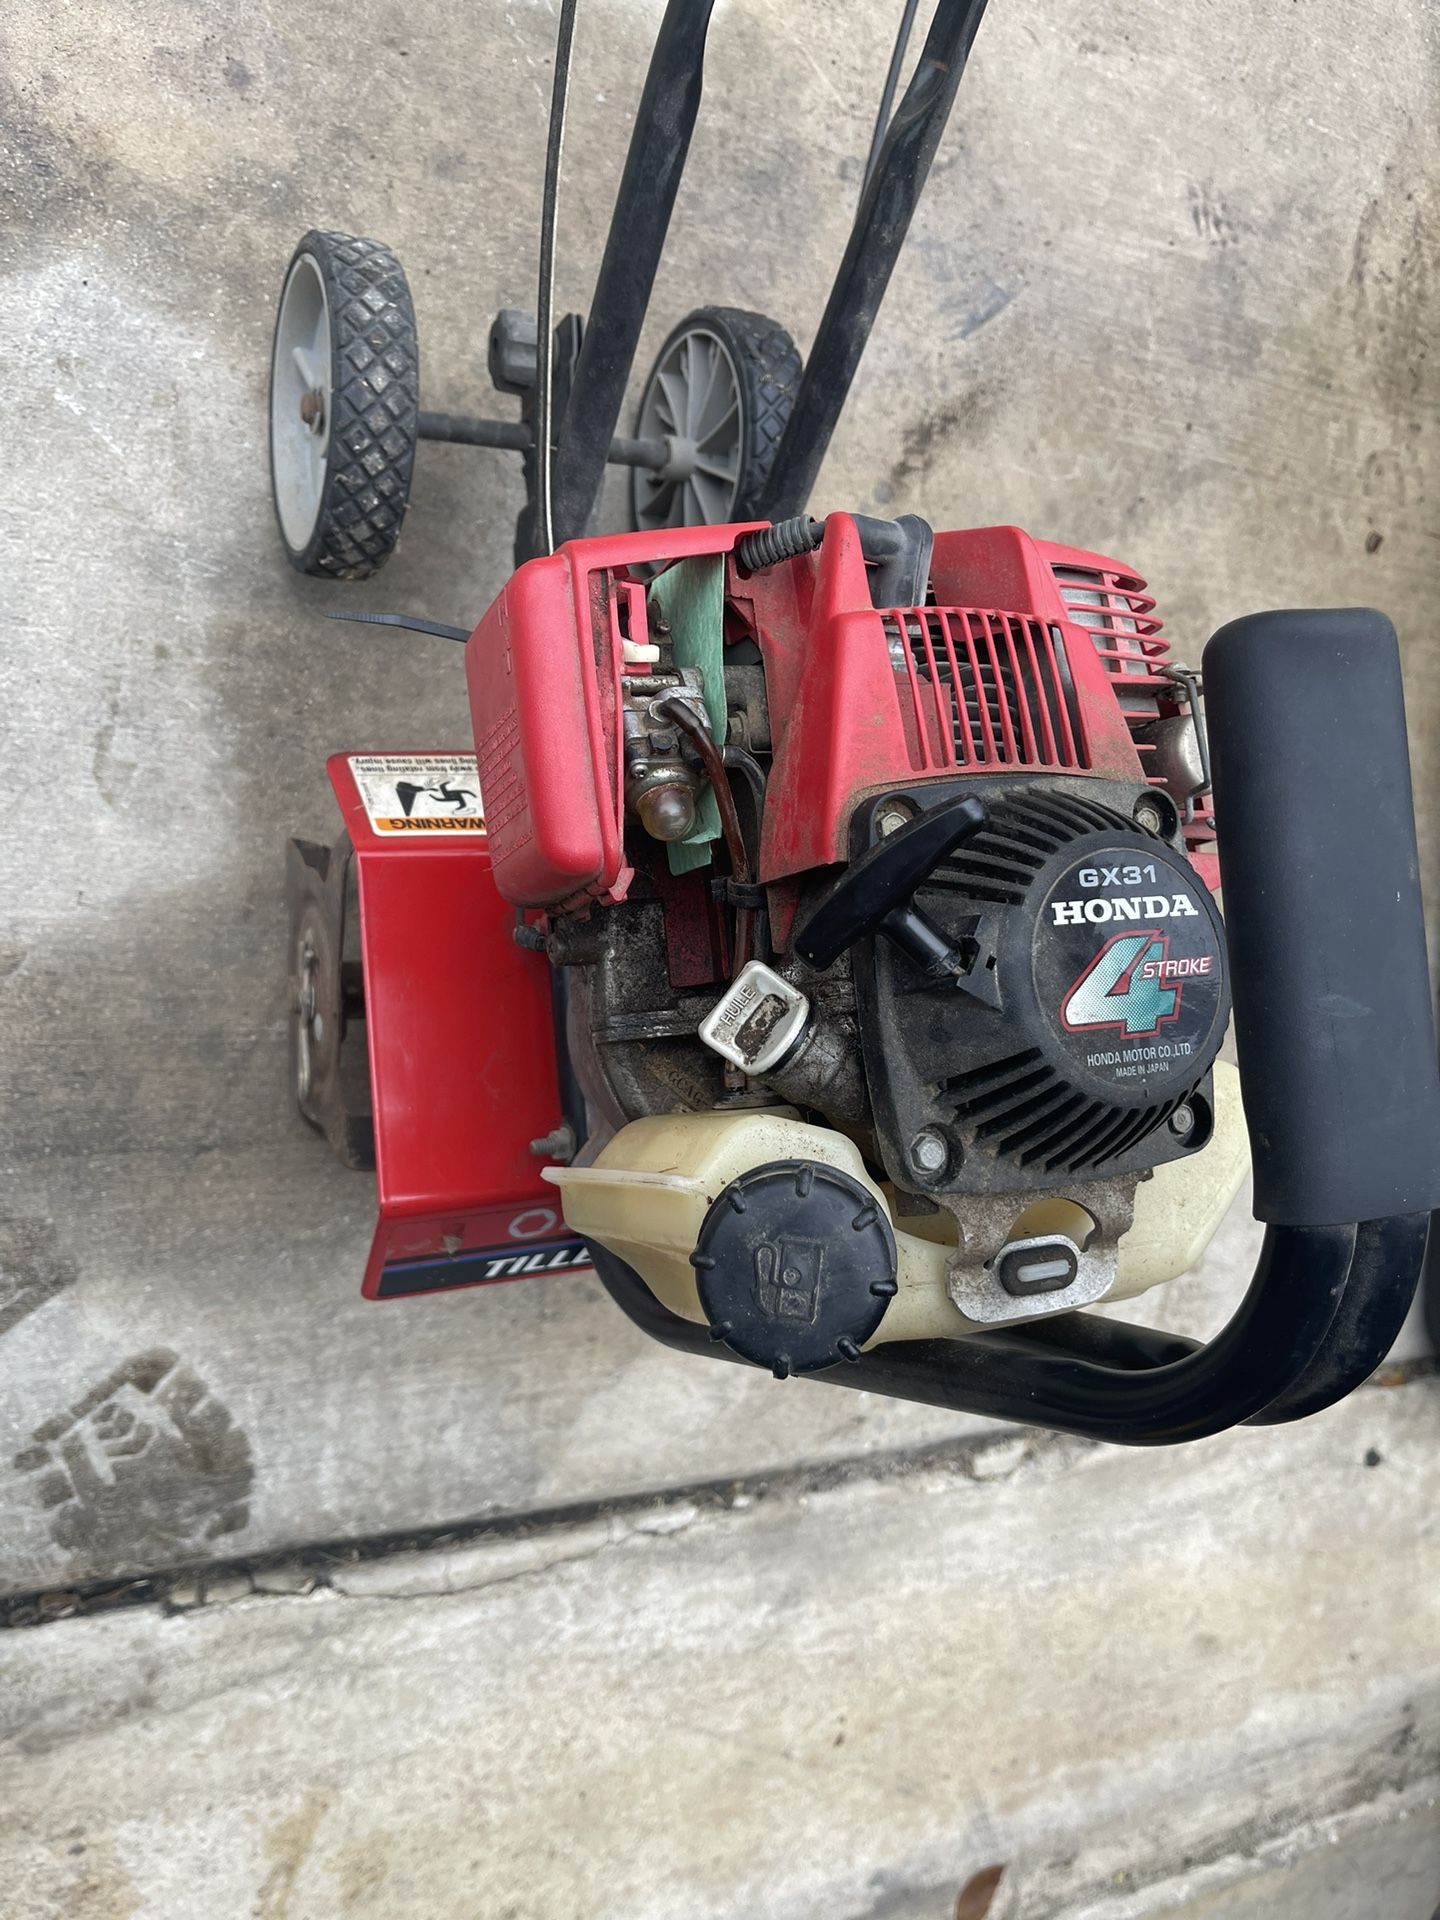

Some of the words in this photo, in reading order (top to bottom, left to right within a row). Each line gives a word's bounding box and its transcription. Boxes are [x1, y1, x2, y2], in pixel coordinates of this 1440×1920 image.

[389, 818, 486, 830] WARNING
[1078, 865, 1157, 888] GX31
[1051, 894, 1199, 926] HONDA
[1141, 956, 1213, 980] STROKE
[1060, 928, 1183, 1040] 4
[720, 984, 756, 1026] HUILE
[1087, 1051, 1122, 1067] HONDA
[1122, 1047, 1157, 1063] MOTOR
[1115, 1065, 1137, 1077] MADE
[1138, 1065, 1145, 1075] IN
[1146, 1062, 1170, 1074] JAPAN
